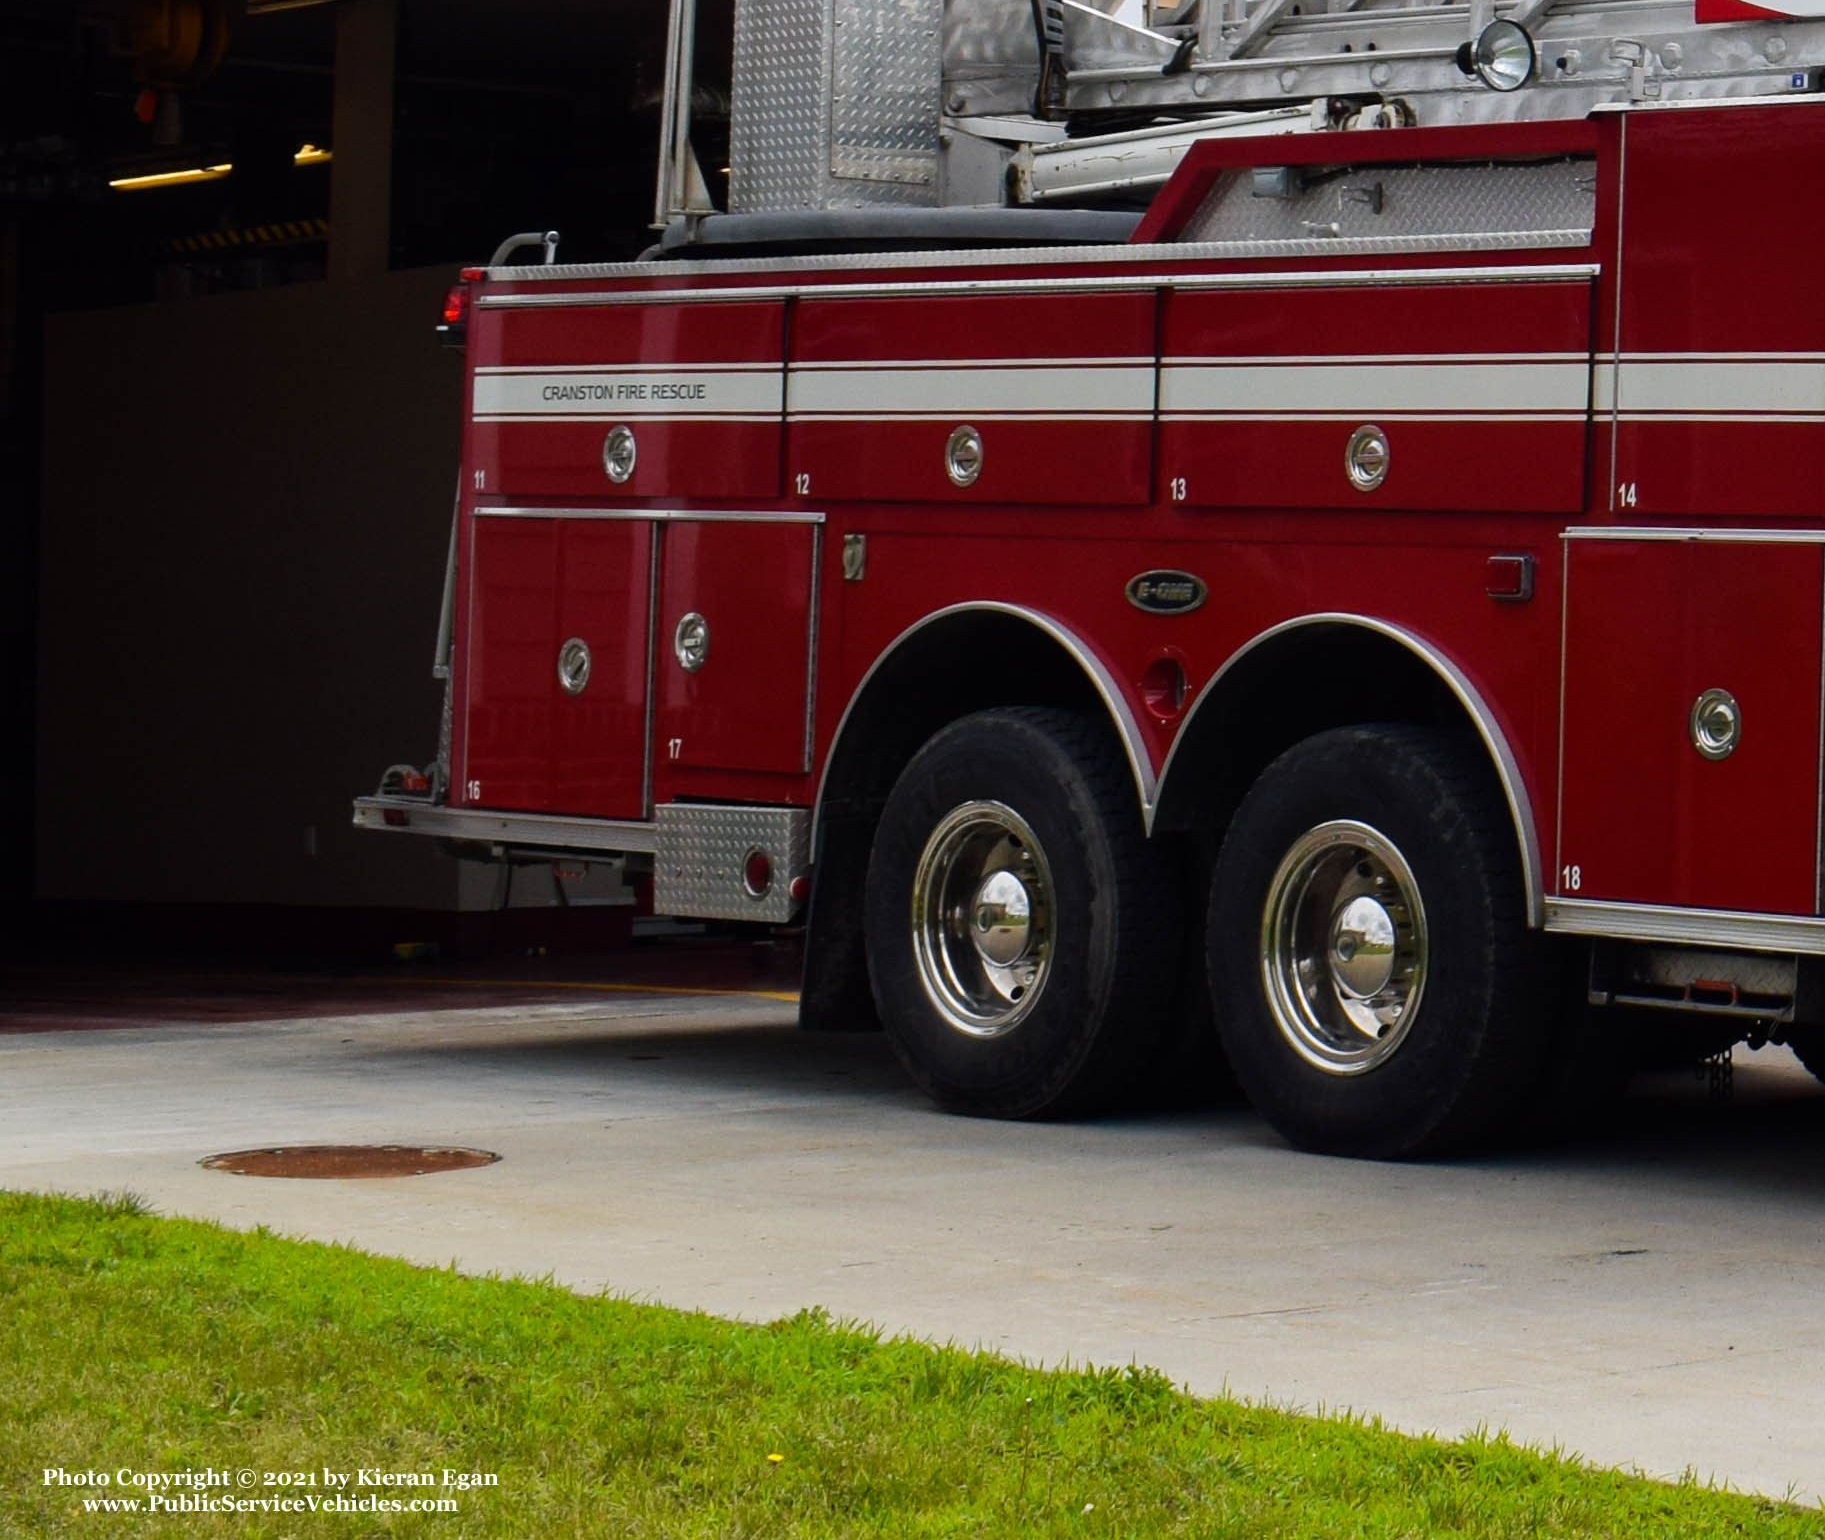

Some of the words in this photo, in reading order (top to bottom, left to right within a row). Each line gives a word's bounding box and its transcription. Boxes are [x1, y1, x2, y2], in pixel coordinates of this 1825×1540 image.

[542, 385, 614, 400] CRANSTON
[617, 385, 647, 399] FIRE
[651, 384, 706, 399] RESCUE
[474, 470, 485, 489] 11
[796, 474, 810, 495] 12
[1171, 478, 1186, 500] 13
[1618, 483, 1637, 508] 14
[668, 740, 682, 759] 17
[468, 781, 480, 801] 16
[1563, 865, 1581, 890] 18
